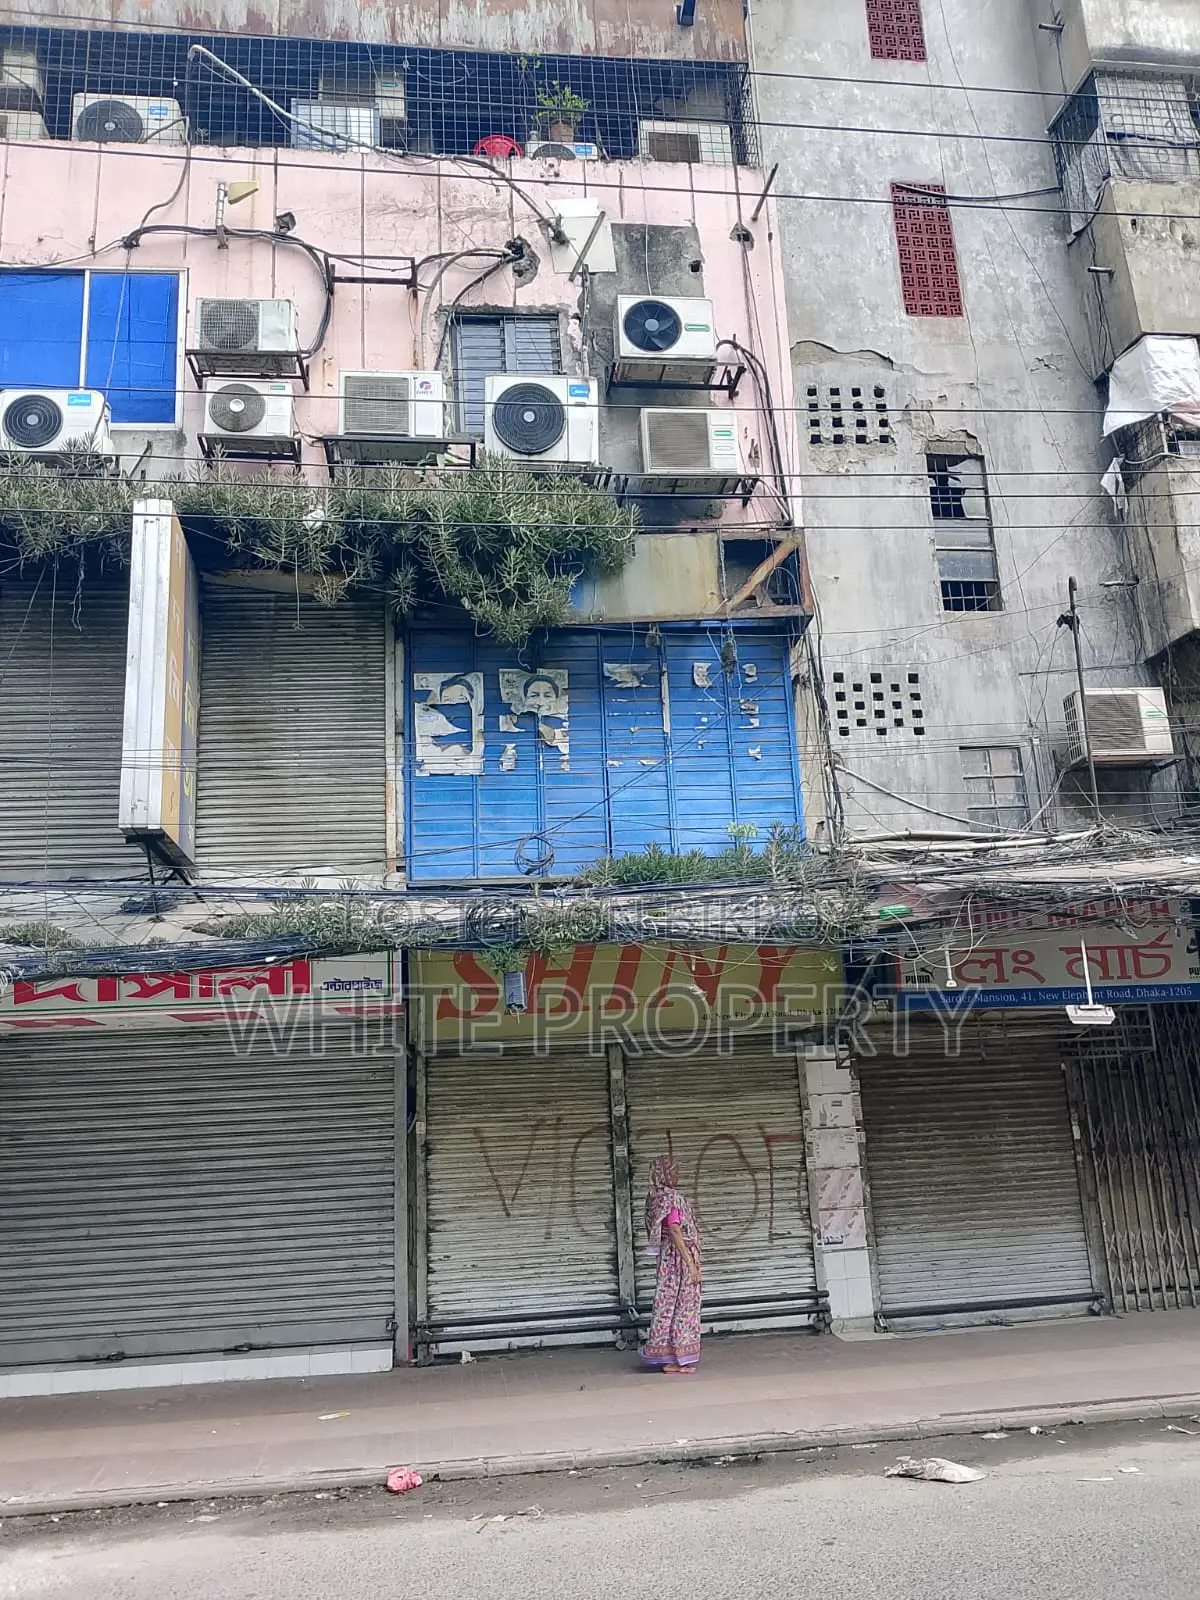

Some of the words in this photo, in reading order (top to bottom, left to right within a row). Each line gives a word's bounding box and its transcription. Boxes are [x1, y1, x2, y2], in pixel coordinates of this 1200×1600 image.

[953, 946, 1047, 985] লং
[1058, 929, 1175, 982] মার্চ
[437, 944, 798, 1021] SHINY
[905, 975, 931, 985] PUMA
[1039, 990, 1060, 1001] New
[1062, 990, 1104, 1002] Elephnt
[1106, 987, 1135, 999] Road,
[1136, 985, 1193, 998] Dhaka-1205
